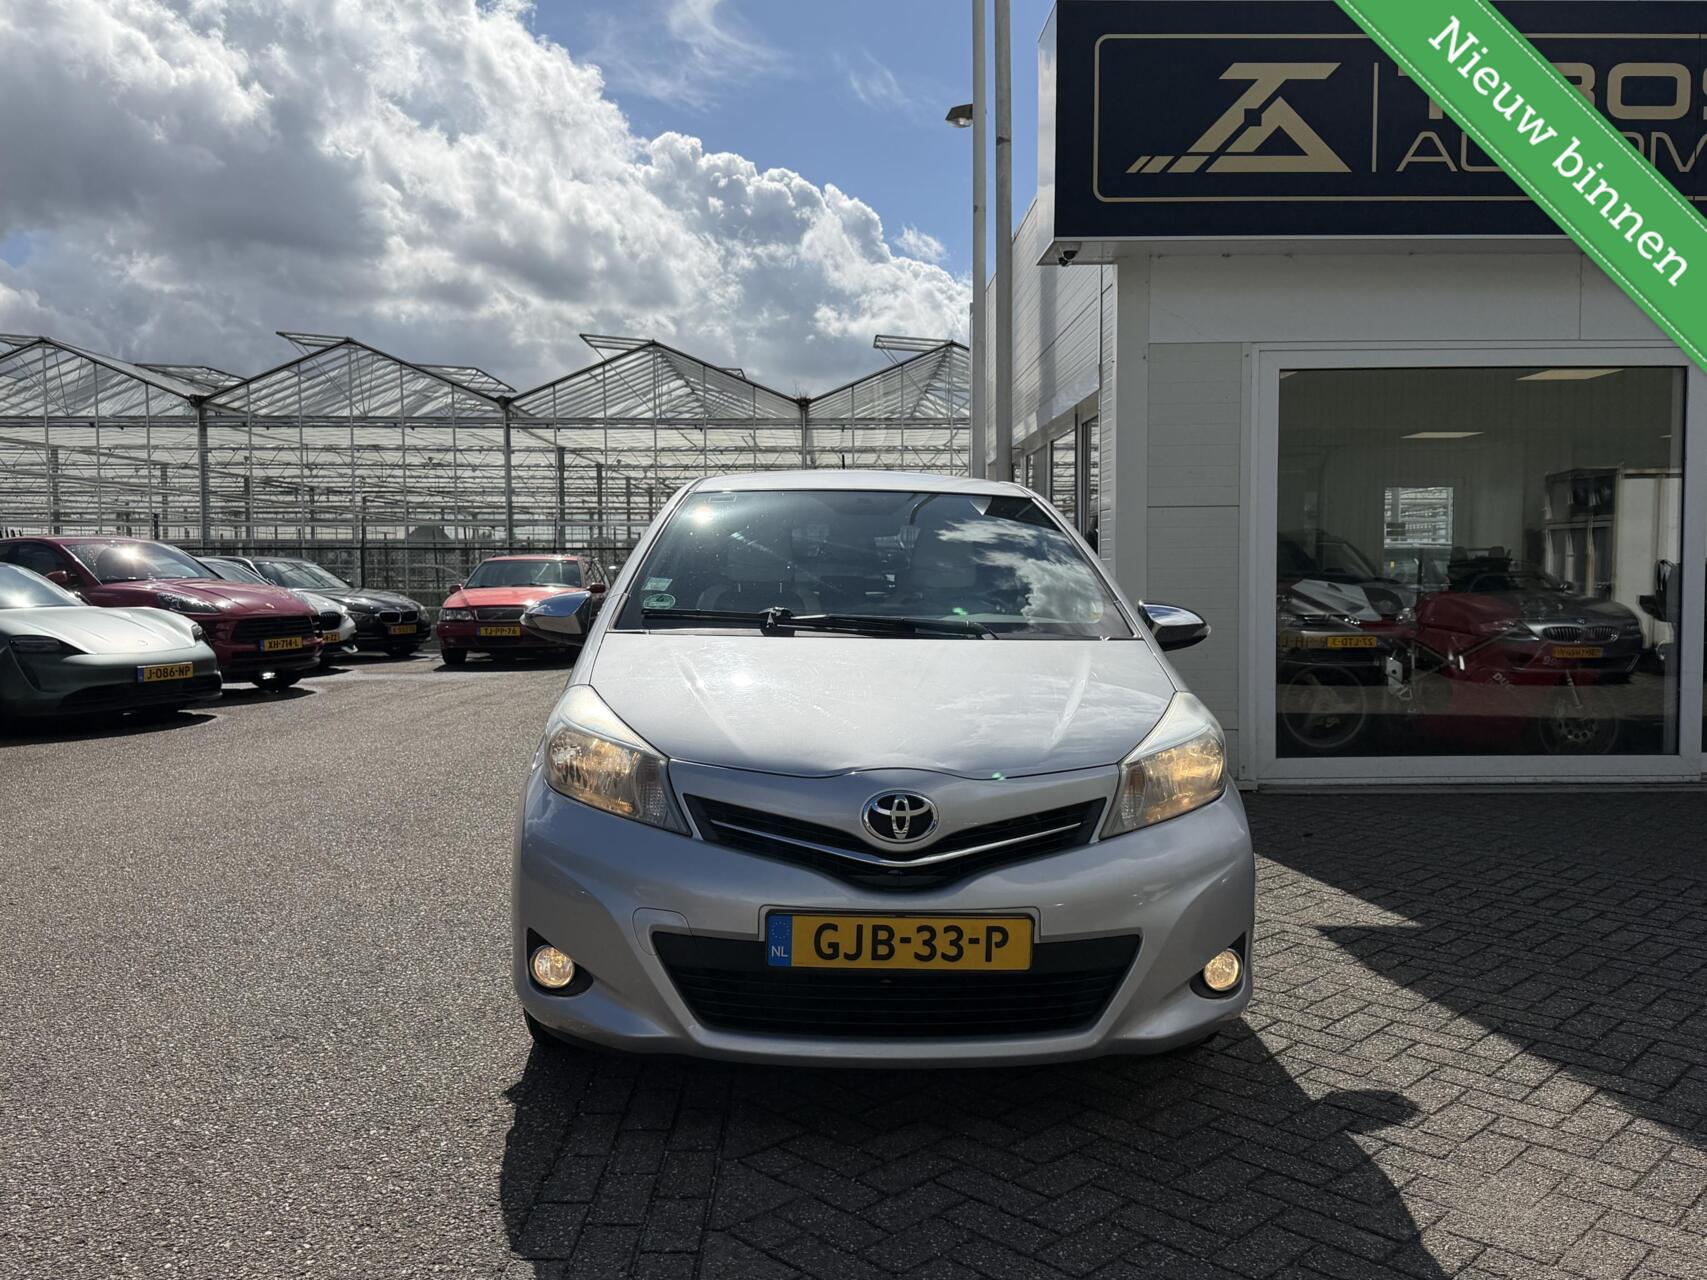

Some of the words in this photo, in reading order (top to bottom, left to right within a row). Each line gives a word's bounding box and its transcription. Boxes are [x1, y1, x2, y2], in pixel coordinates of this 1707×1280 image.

[268, 639, 300, 649] XH-714-L
[147, 666, 191, 680] J-086-NP
[771, 945, 788, 958] NL
[813, 922, 1009, 963] GJB-33-P
